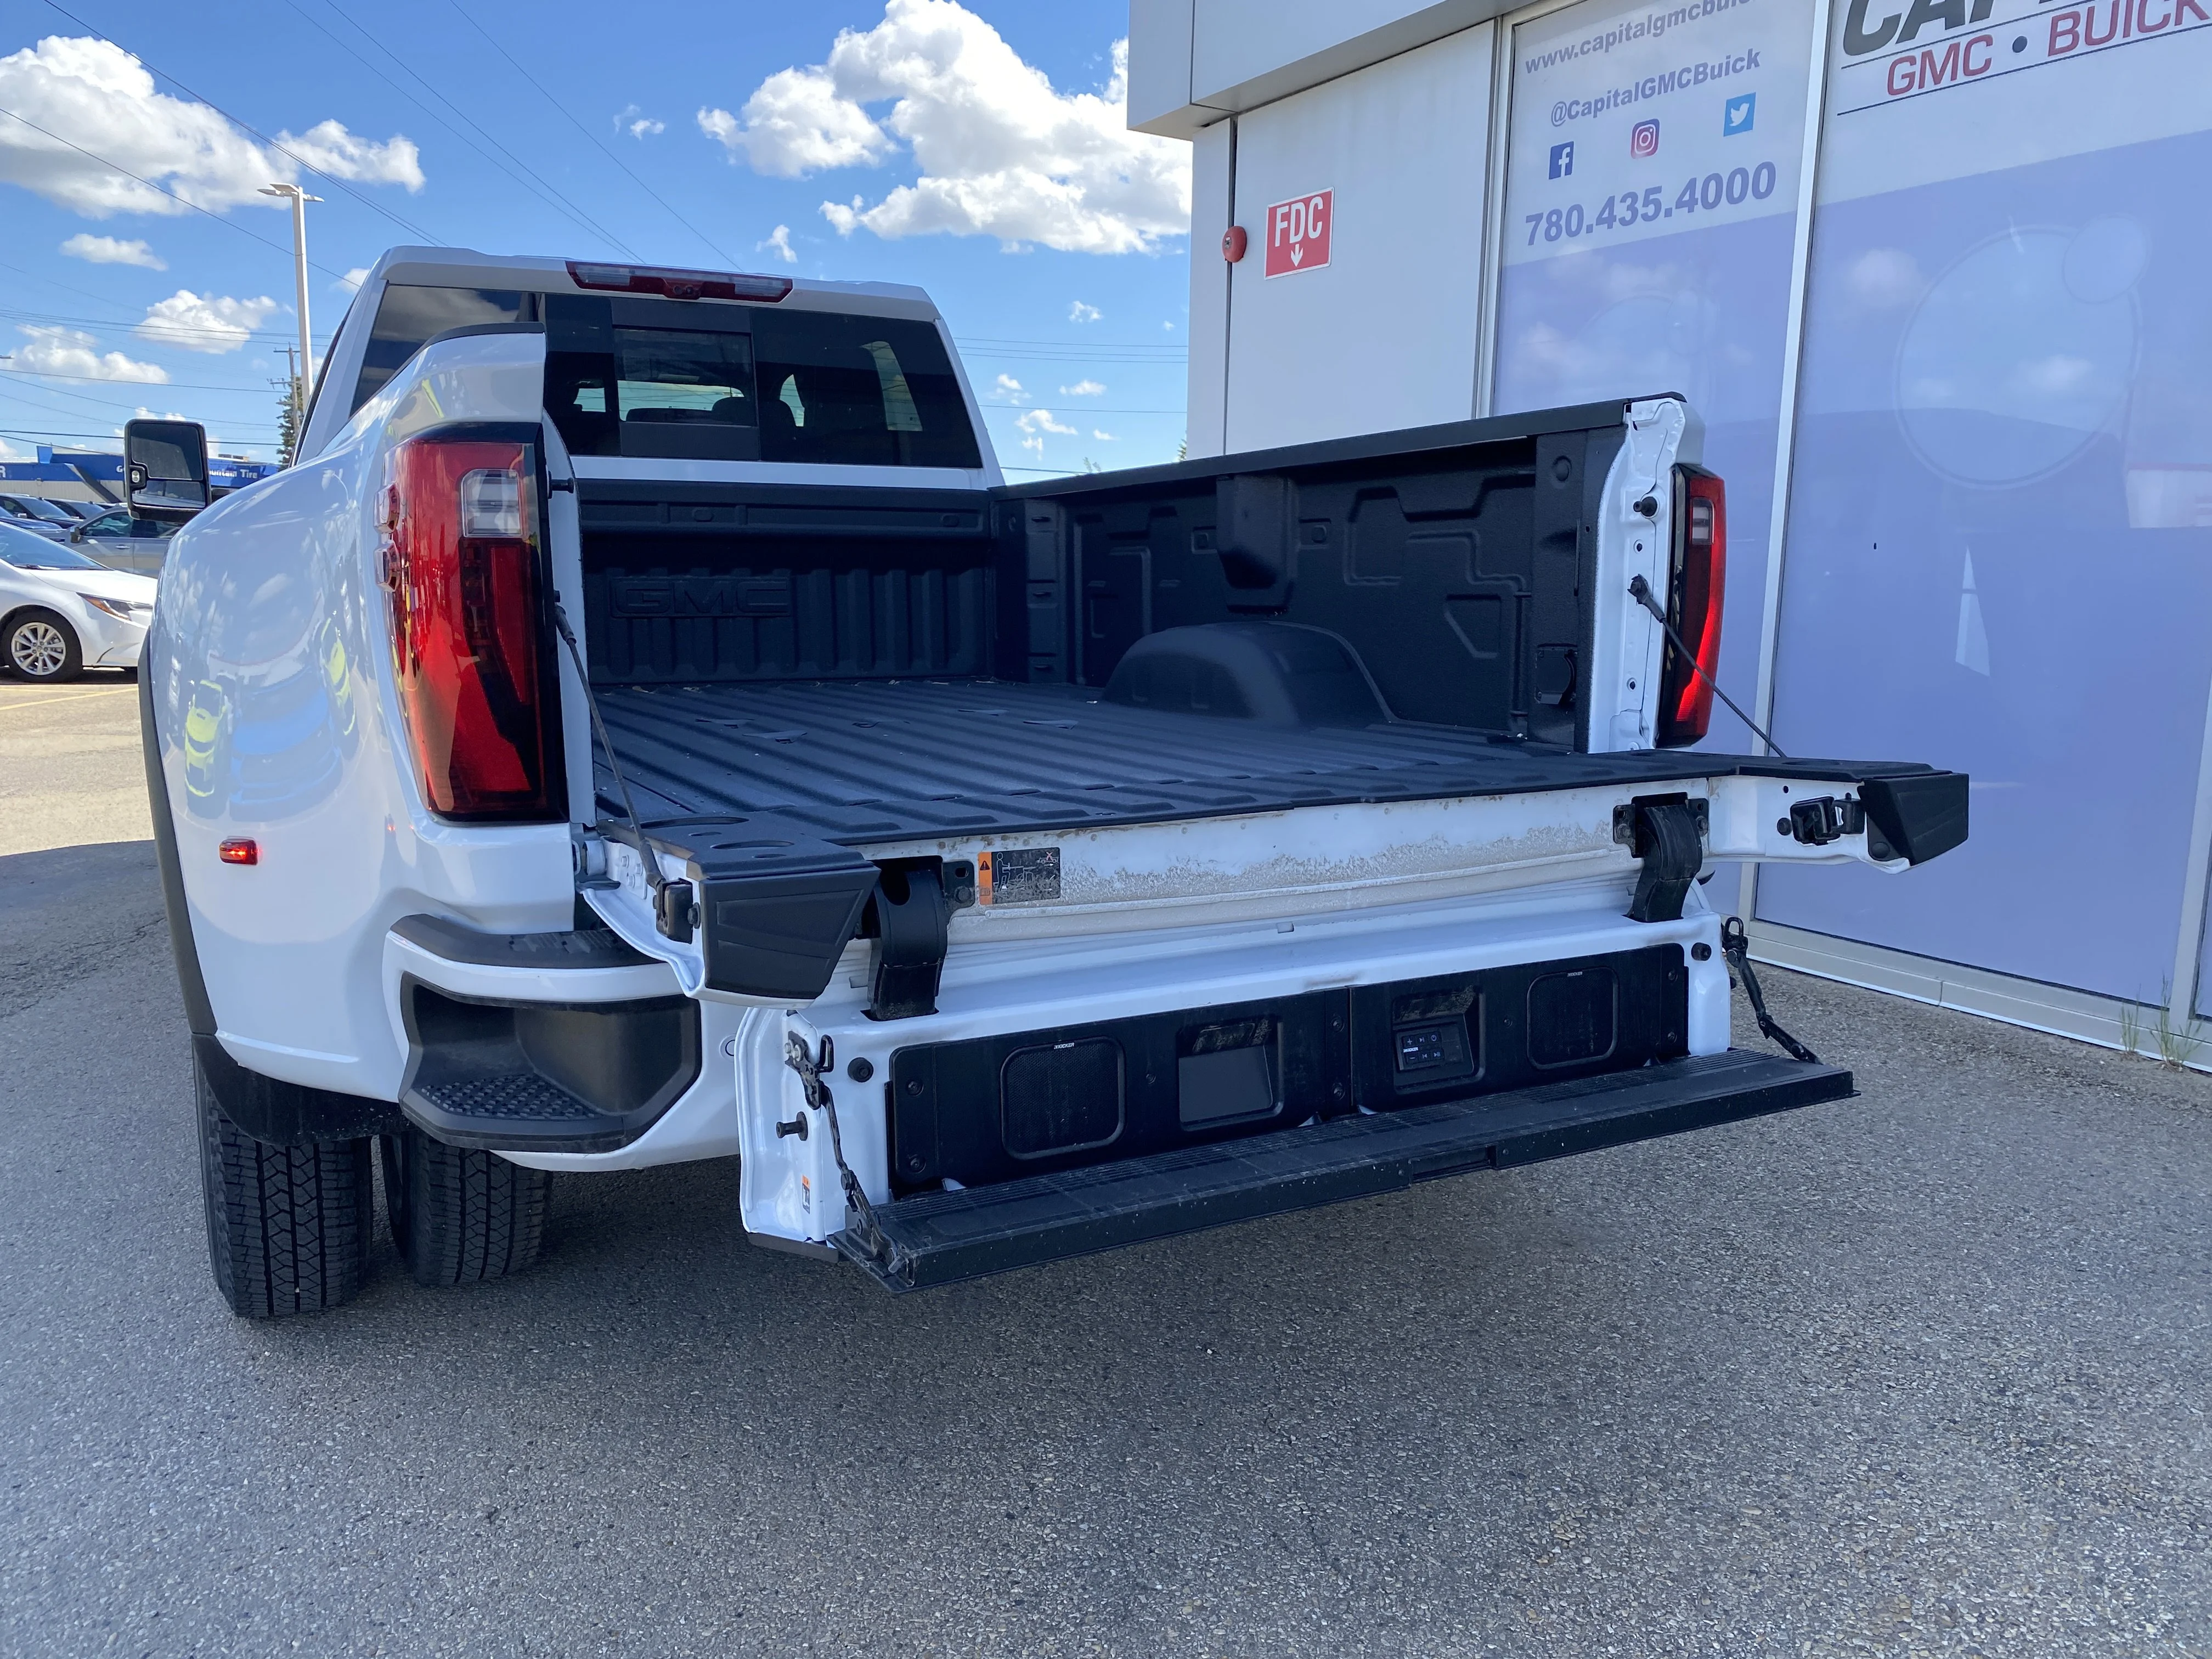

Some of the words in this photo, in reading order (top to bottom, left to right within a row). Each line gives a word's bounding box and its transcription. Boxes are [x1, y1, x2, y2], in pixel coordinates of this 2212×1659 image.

[1525, 0, 1751, 74] www.capitalgmcbu
[1887, 34, 1993, 95] GMC
[2047, 0, 2211, 57] BUICK
[1551, 48, 1760, 127] @CapitalGMCBuick
[1275, 196, 1323, 247] FDC
[1525, 161, 1776, 246] 780.435.4000
[240, 469, 258, 479] Tire
[615, 580, 788, 614] GMC
